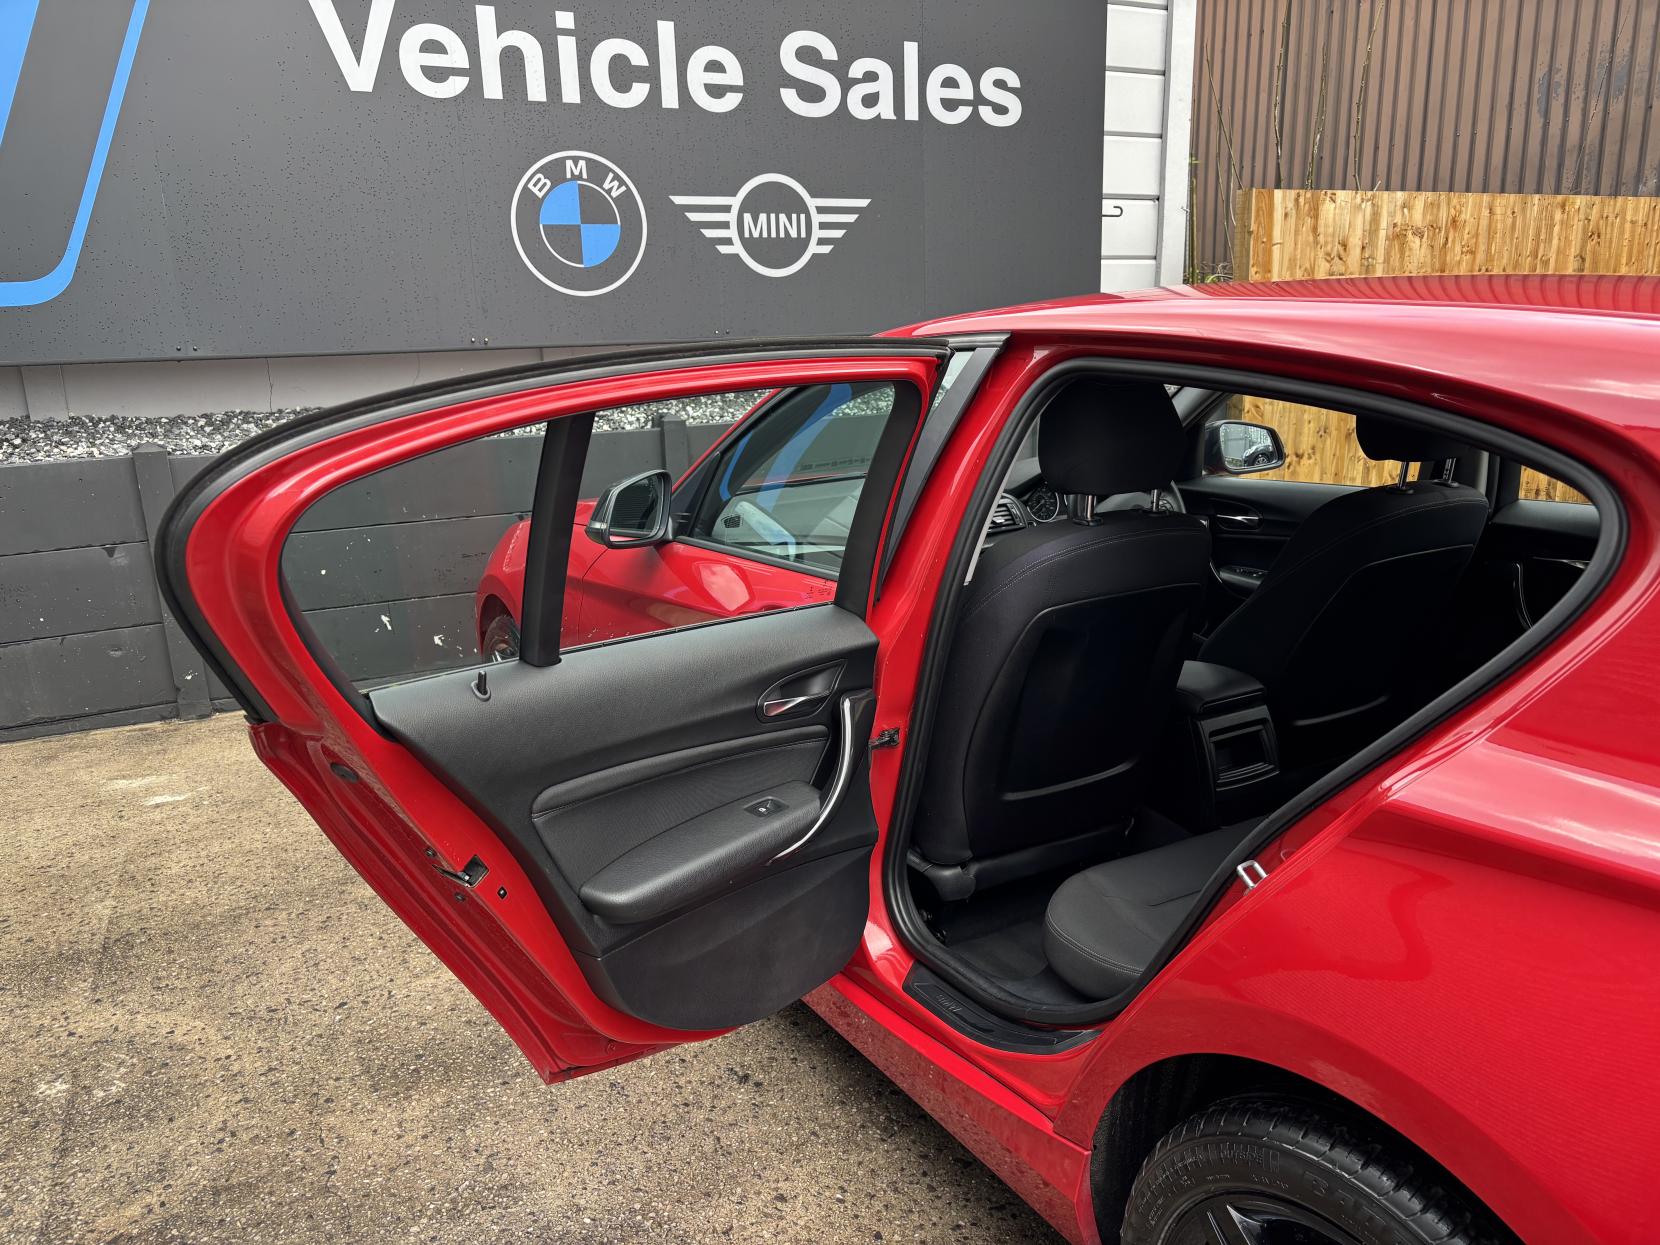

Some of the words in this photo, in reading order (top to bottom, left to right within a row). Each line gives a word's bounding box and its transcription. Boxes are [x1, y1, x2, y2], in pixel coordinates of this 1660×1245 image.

[308, 0, 743, 113] Vehicle
[780, 31, 1022, 126] Sales
[528, 159, 627, 199] BMW
[743, 212, 807, 239] MINI
